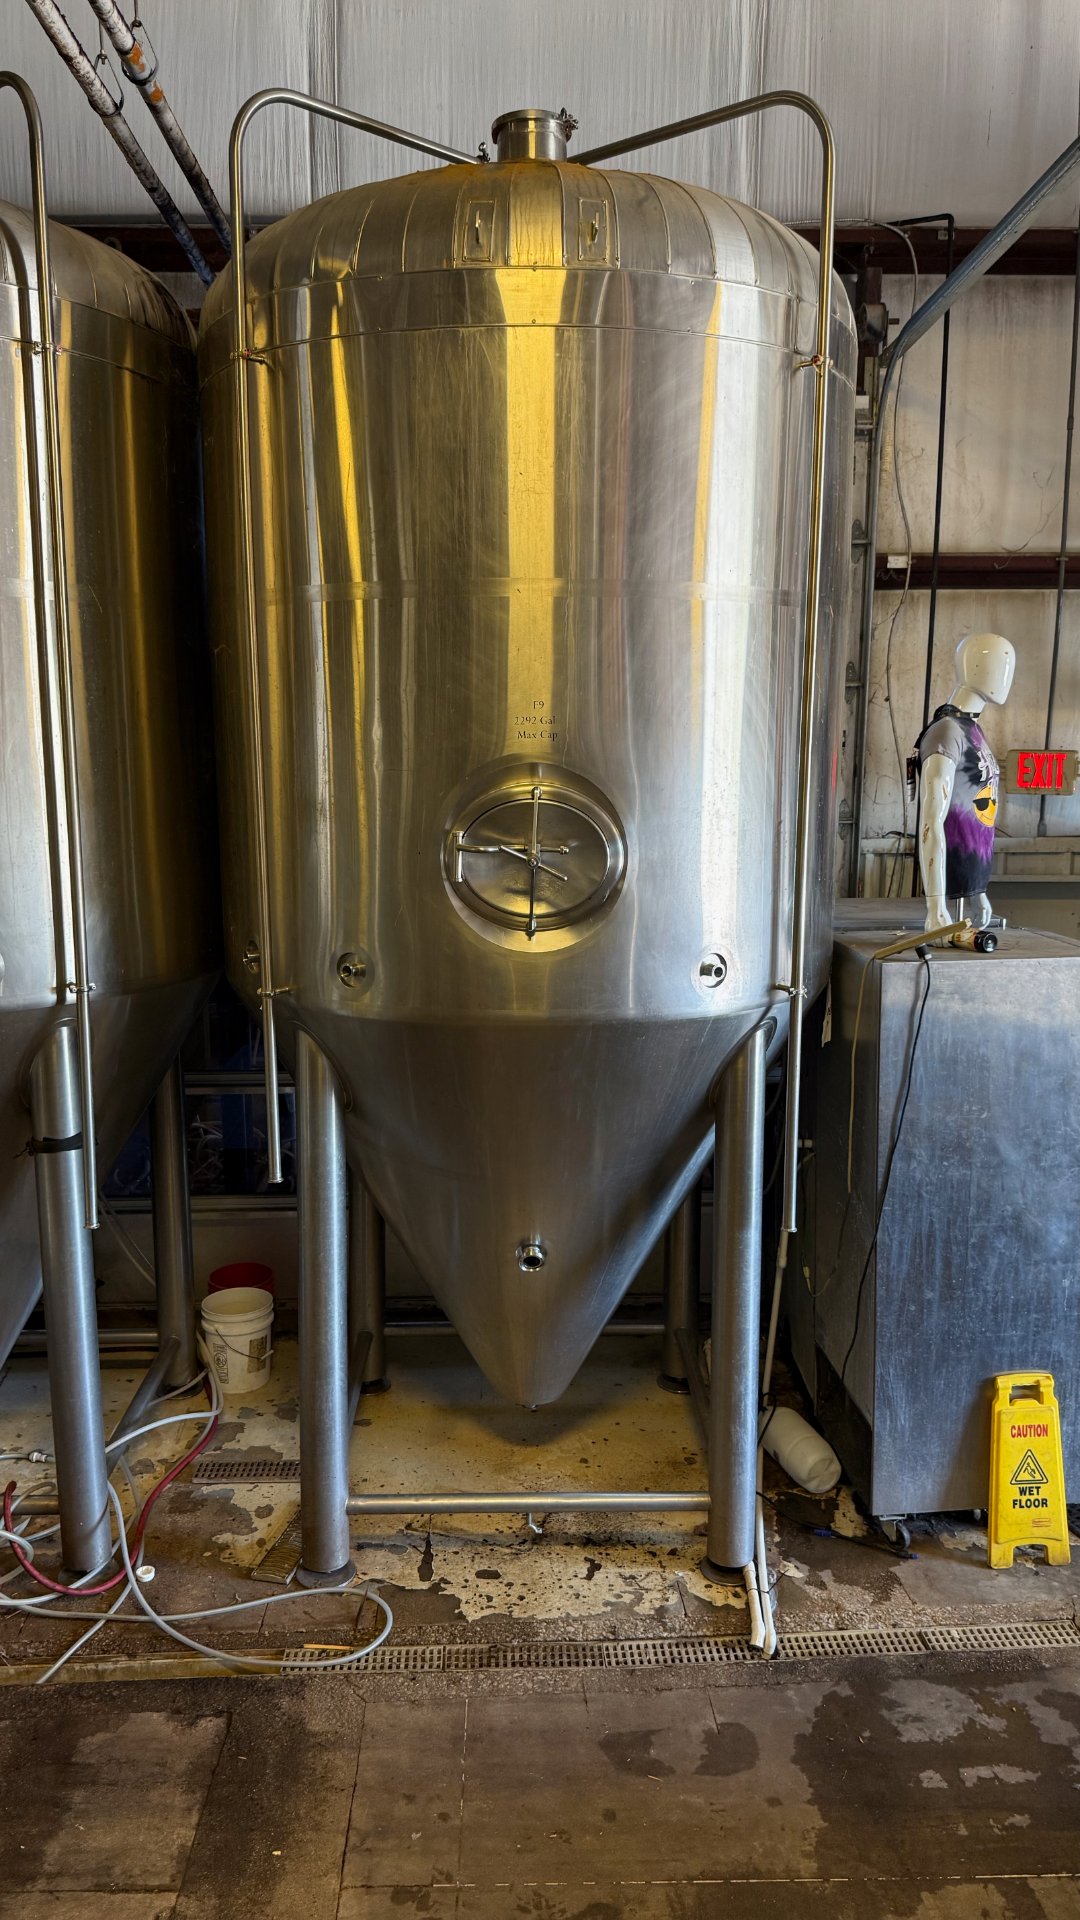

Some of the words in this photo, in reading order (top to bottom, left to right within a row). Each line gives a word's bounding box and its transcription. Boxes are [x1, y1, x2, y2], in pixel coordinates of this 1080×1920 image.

[533, 700, 545, 710] F9
[514, 716, 537, 726] 2292
[540, 715, 556, 725] Gal
[517, 730, 537, 740] Max
[540, 730, 558, 742] Cap
[1017, 751, 1067, 789] EXIT
[1010, 1423, 1049, 1439] CAUTION
[1018, 1486, 1042, 1496] WET
[1012, 1498, 1048, 1509] FLOOR
